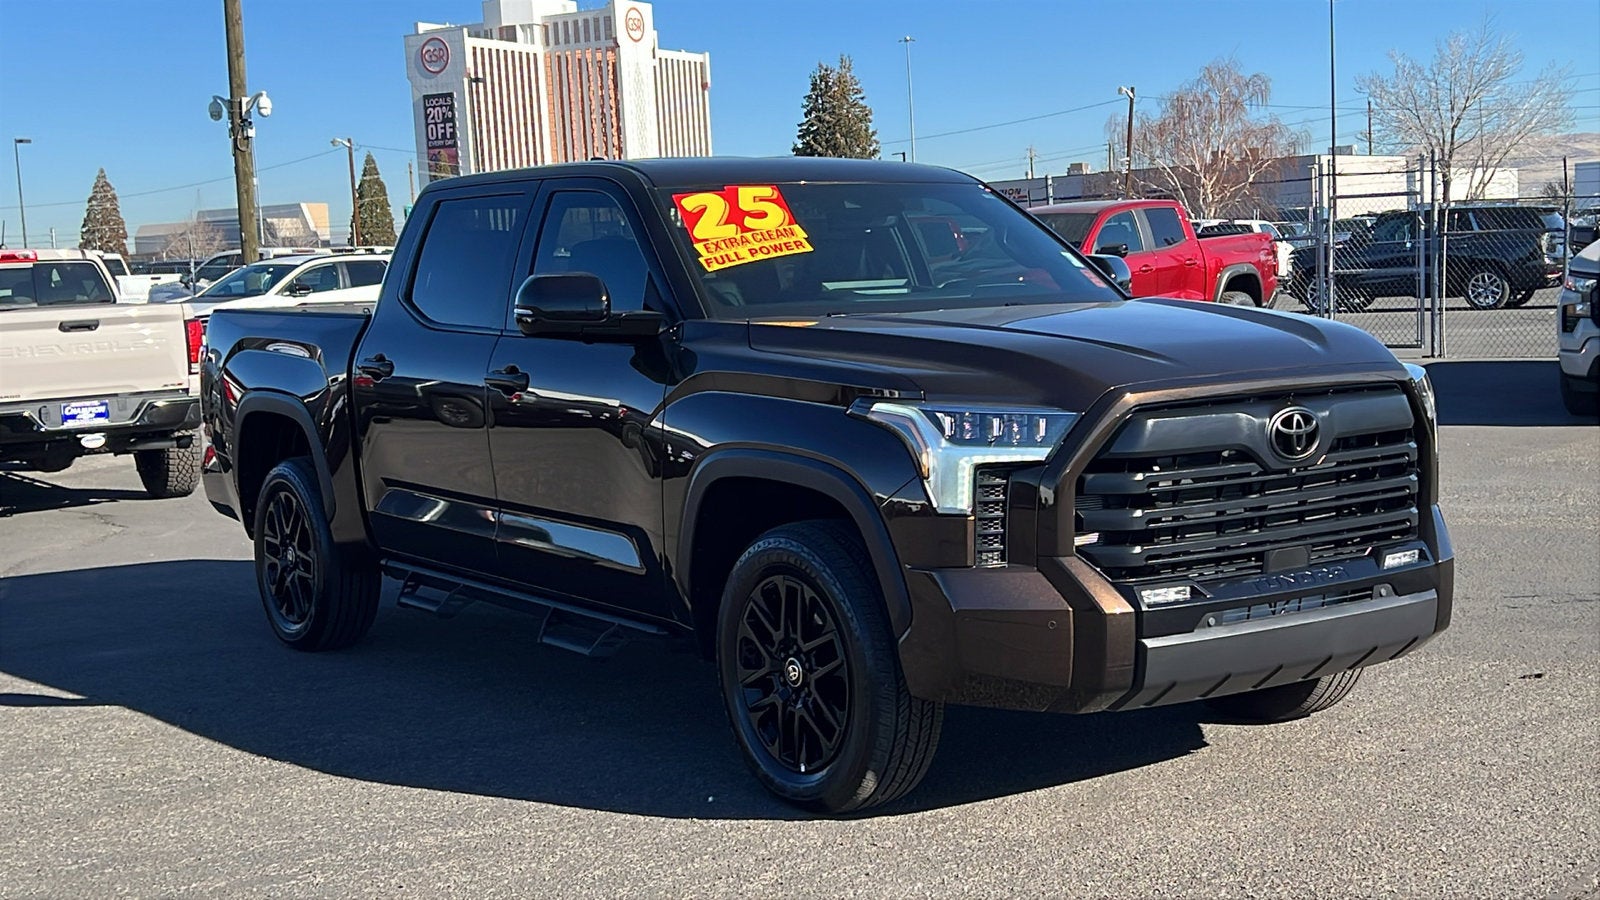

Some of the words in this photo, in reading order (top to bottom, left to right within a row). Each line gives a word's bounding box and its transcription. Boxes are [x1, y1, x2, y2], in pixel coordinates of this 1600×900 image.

[424, 48, 445, 63] GSR
[425, 98, 452, 106] LOCALS
[426, 106, 453, 124] 20%
[428, 122, 453, 140] OFF
[703, 235, 751, 254] EXTRA
[751, 227, 795, 243] CLEAN
[704, 251, 745, 268] FULL
[749, 240, 806, 257] POWER
